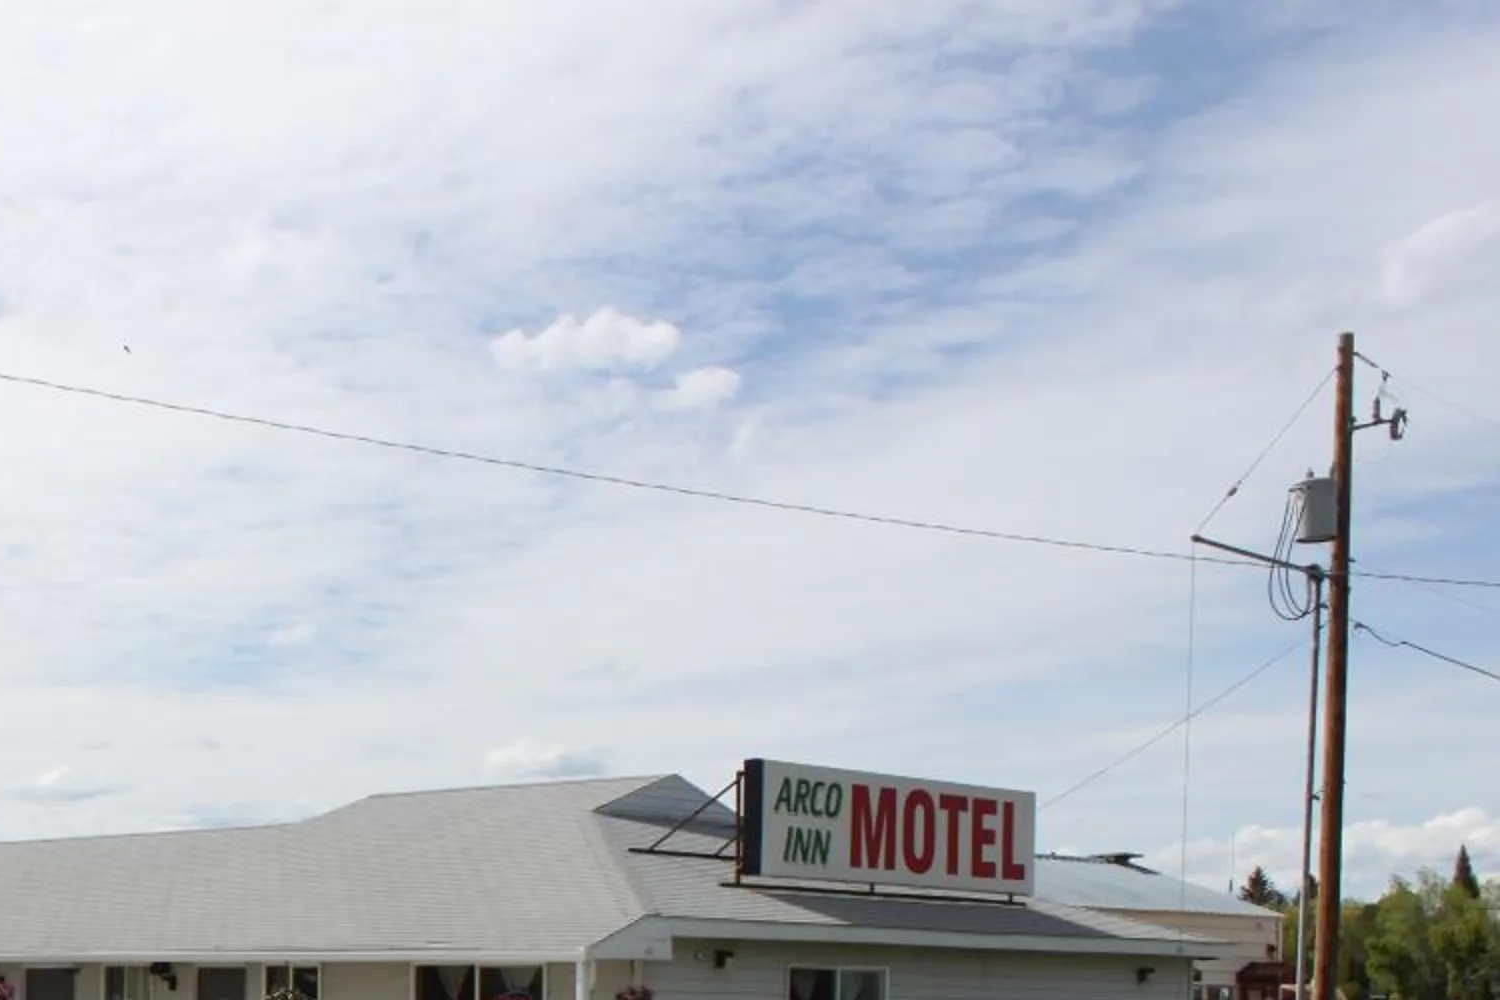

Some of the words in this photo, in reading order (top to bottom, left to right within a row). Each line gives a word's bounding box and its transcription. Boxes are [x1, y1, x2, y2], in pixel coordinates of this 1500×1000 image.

[774, 777, 842, 818] ARCO
[783, 826, 831, 865] INN
[851, 784, 1025, 880] MOTEL
